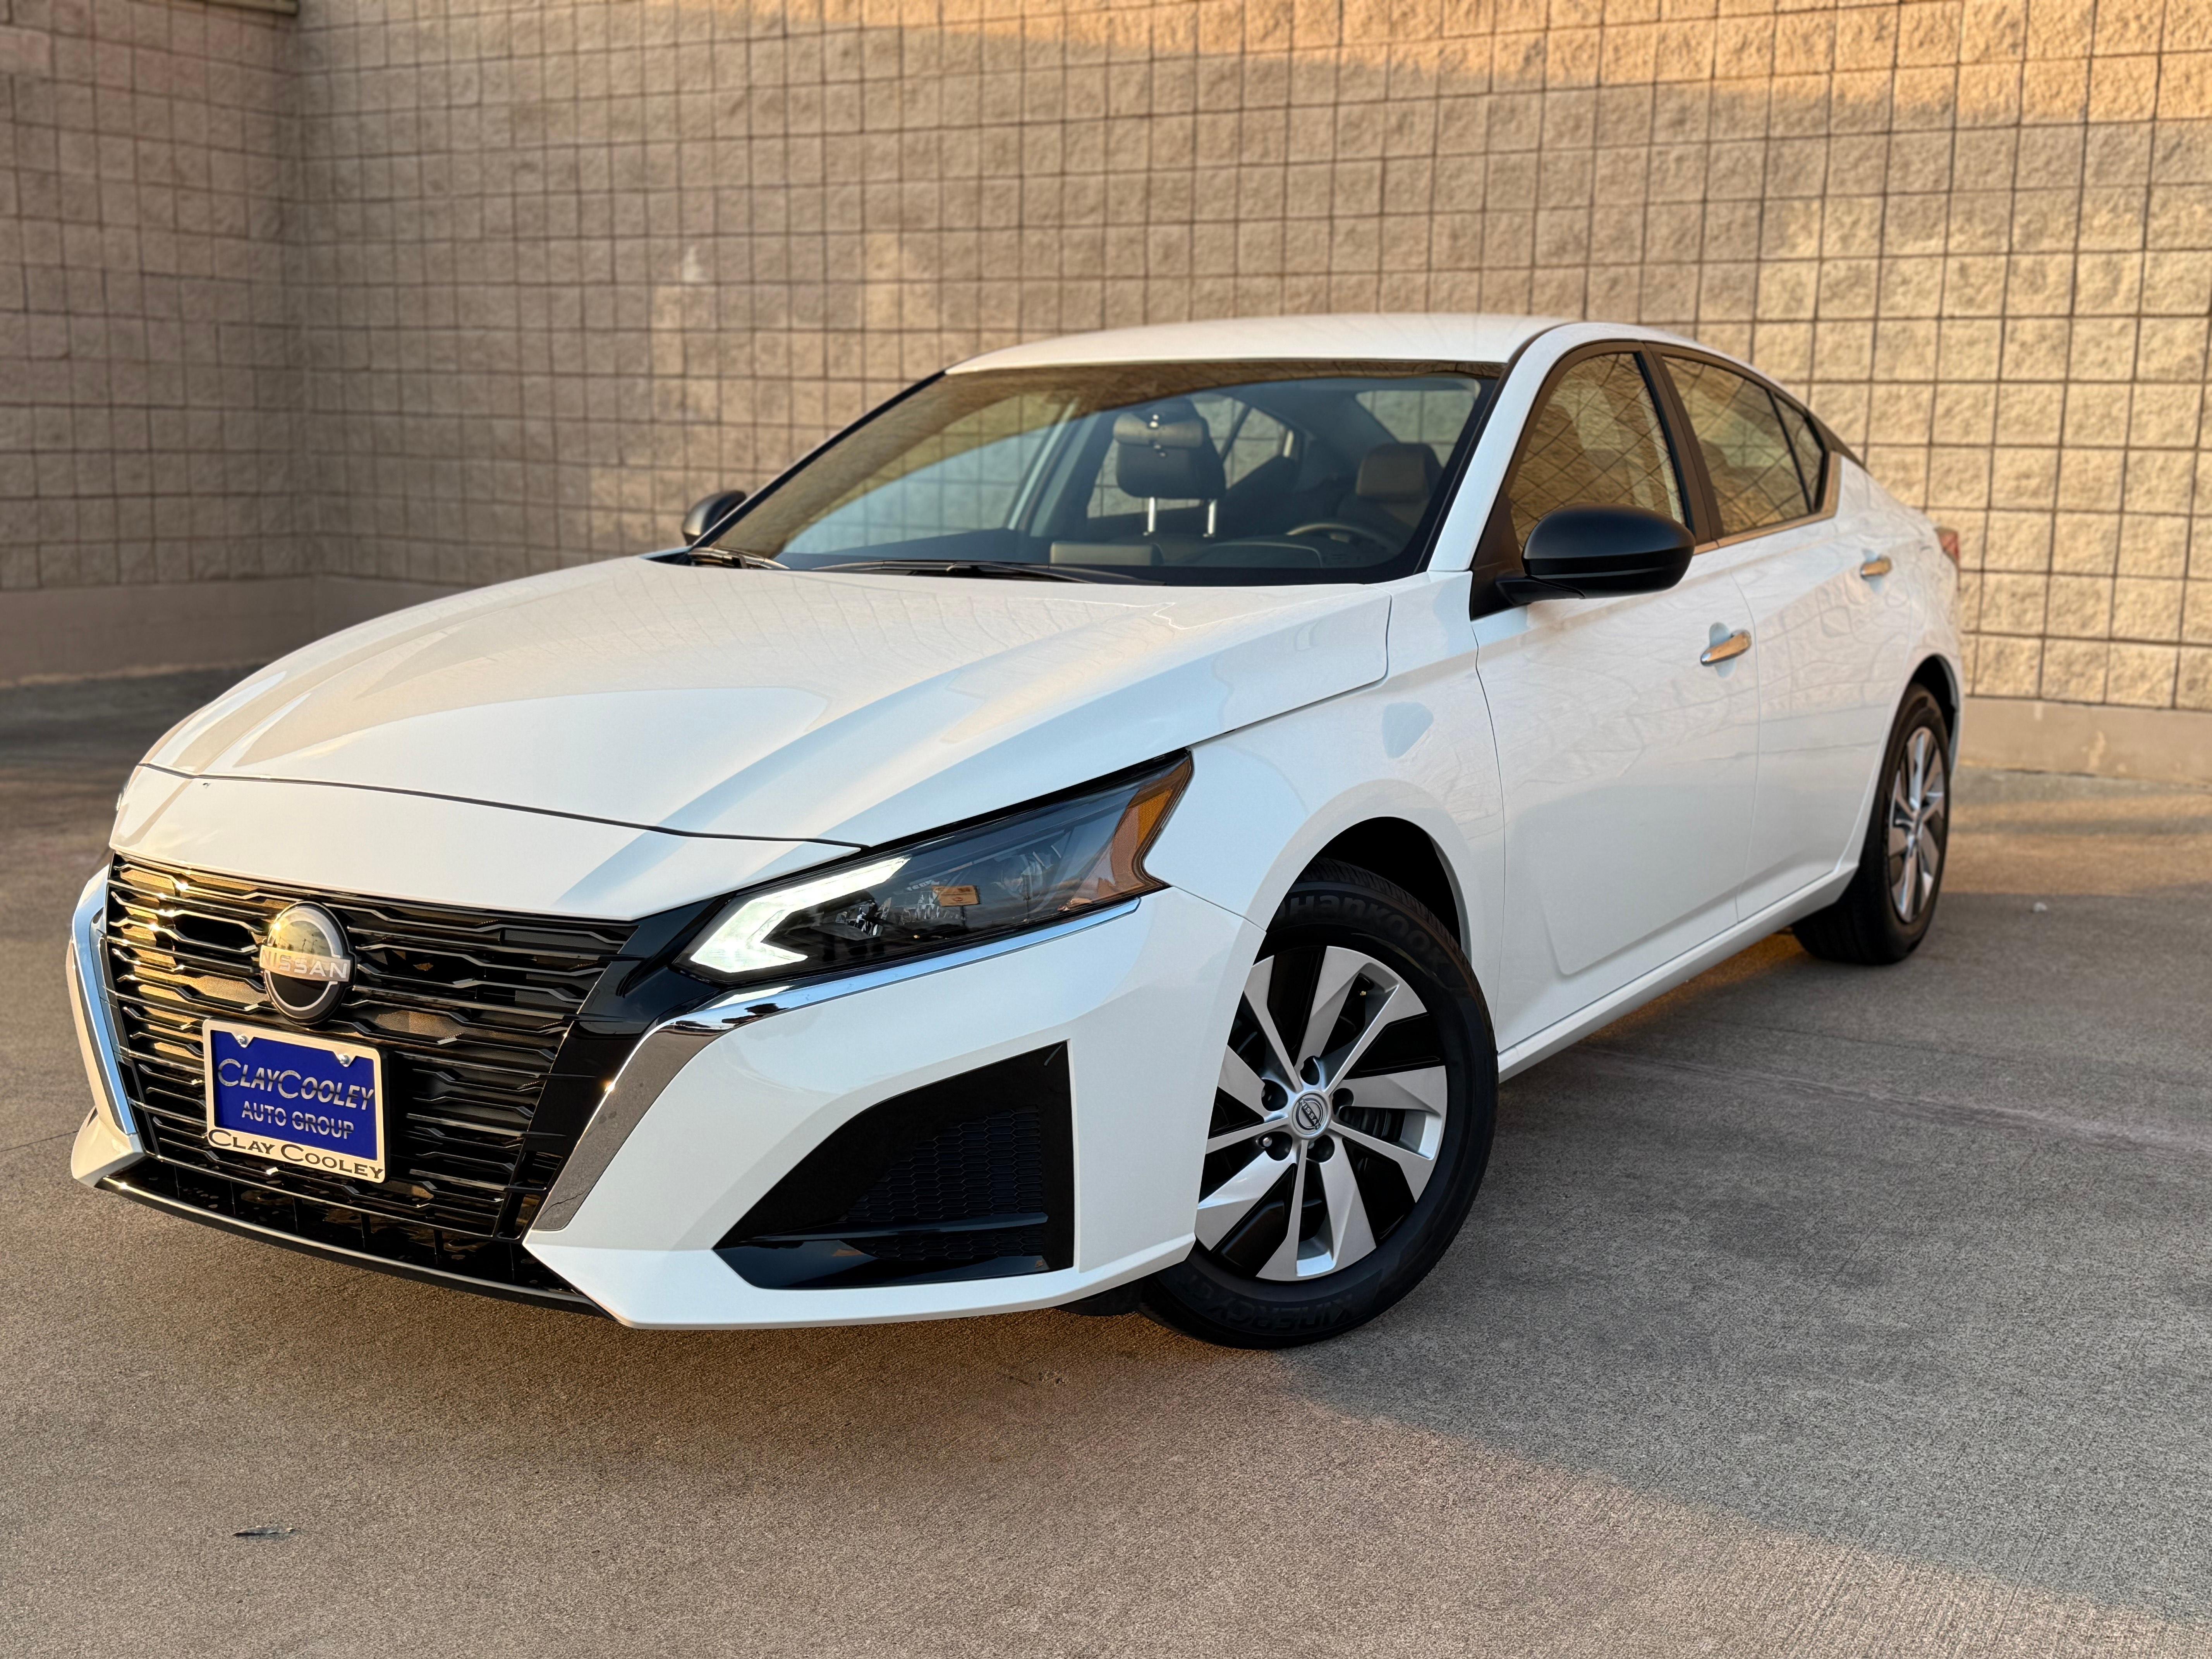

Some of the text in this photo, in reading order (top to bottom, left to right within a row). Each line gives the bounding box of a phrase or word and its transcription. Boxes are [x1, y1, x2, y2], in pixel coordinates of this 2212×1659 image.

[262, 950, 347, 979] NISSAN
[242, 1101, 354, 1139] AUTO GROUP
[1300, 1099, 1320, 1128] NISSAN
[208, 1129, 384, 1179] CLAY COOLEY
